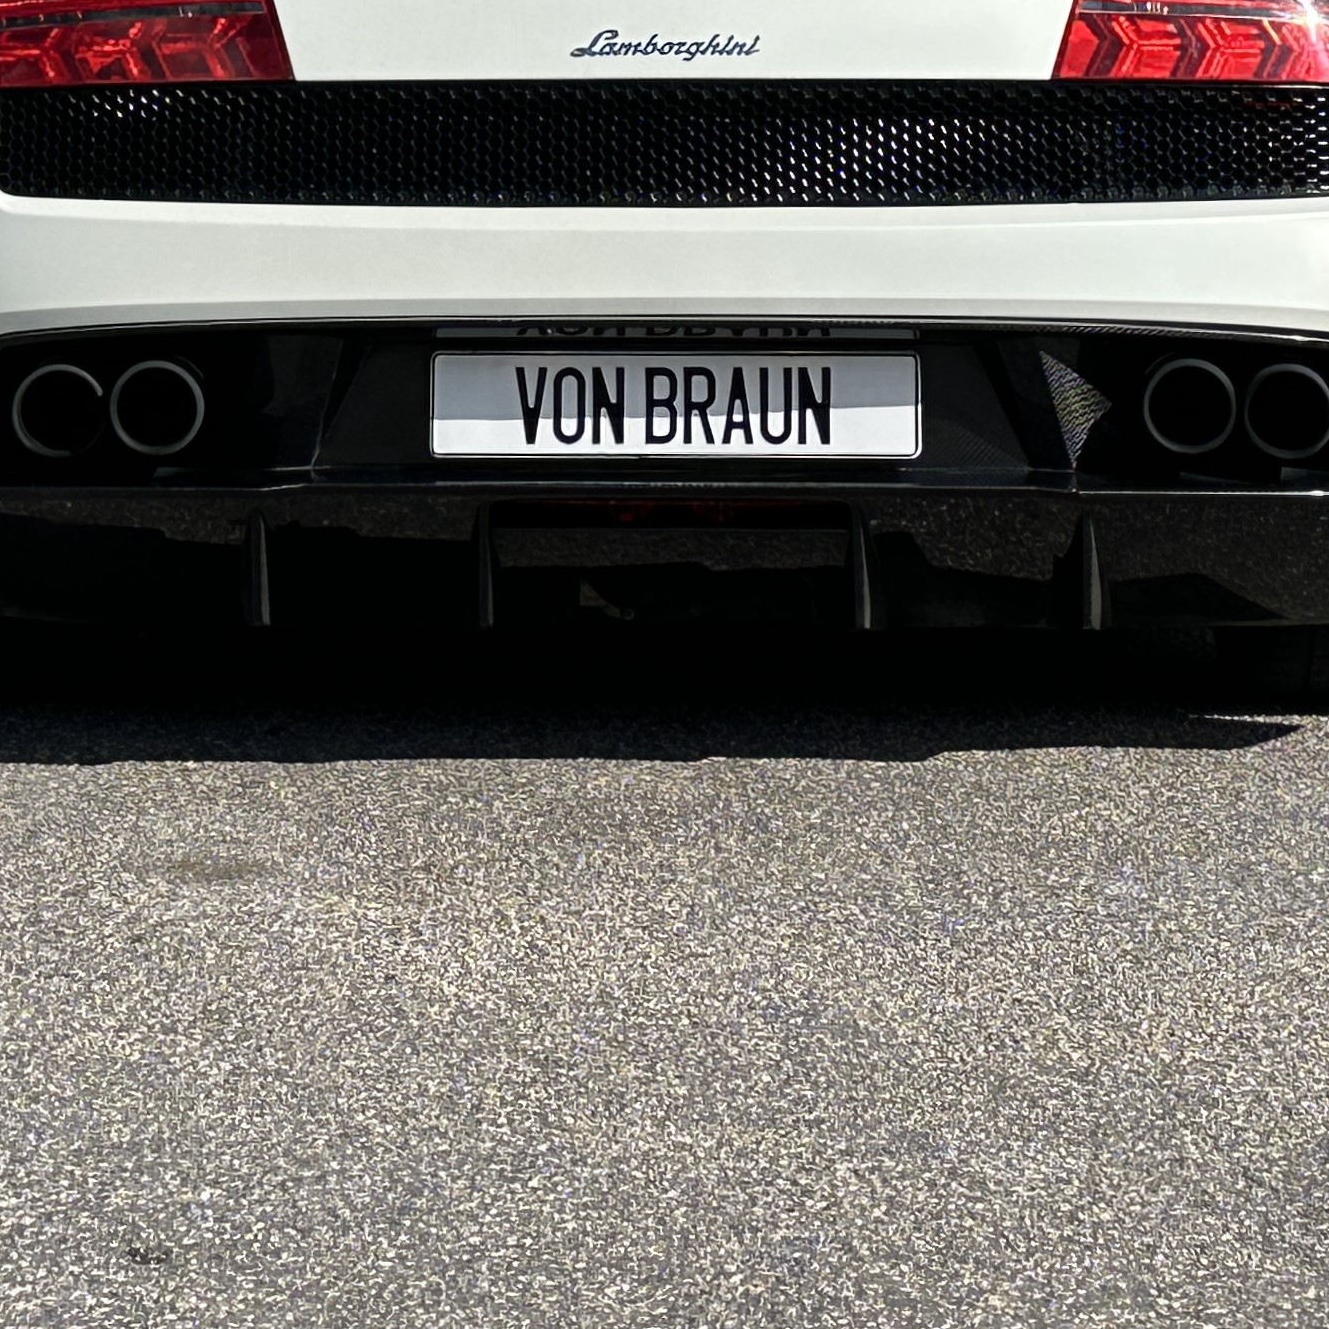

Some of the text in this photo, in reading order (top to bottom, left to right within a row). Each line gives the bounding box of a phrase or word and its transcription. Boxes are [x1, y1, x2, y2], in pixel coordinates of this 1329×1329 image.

[570, 29, 760, 61] Lamborghini
[515, 366, 831, 445] VON BRAUN
